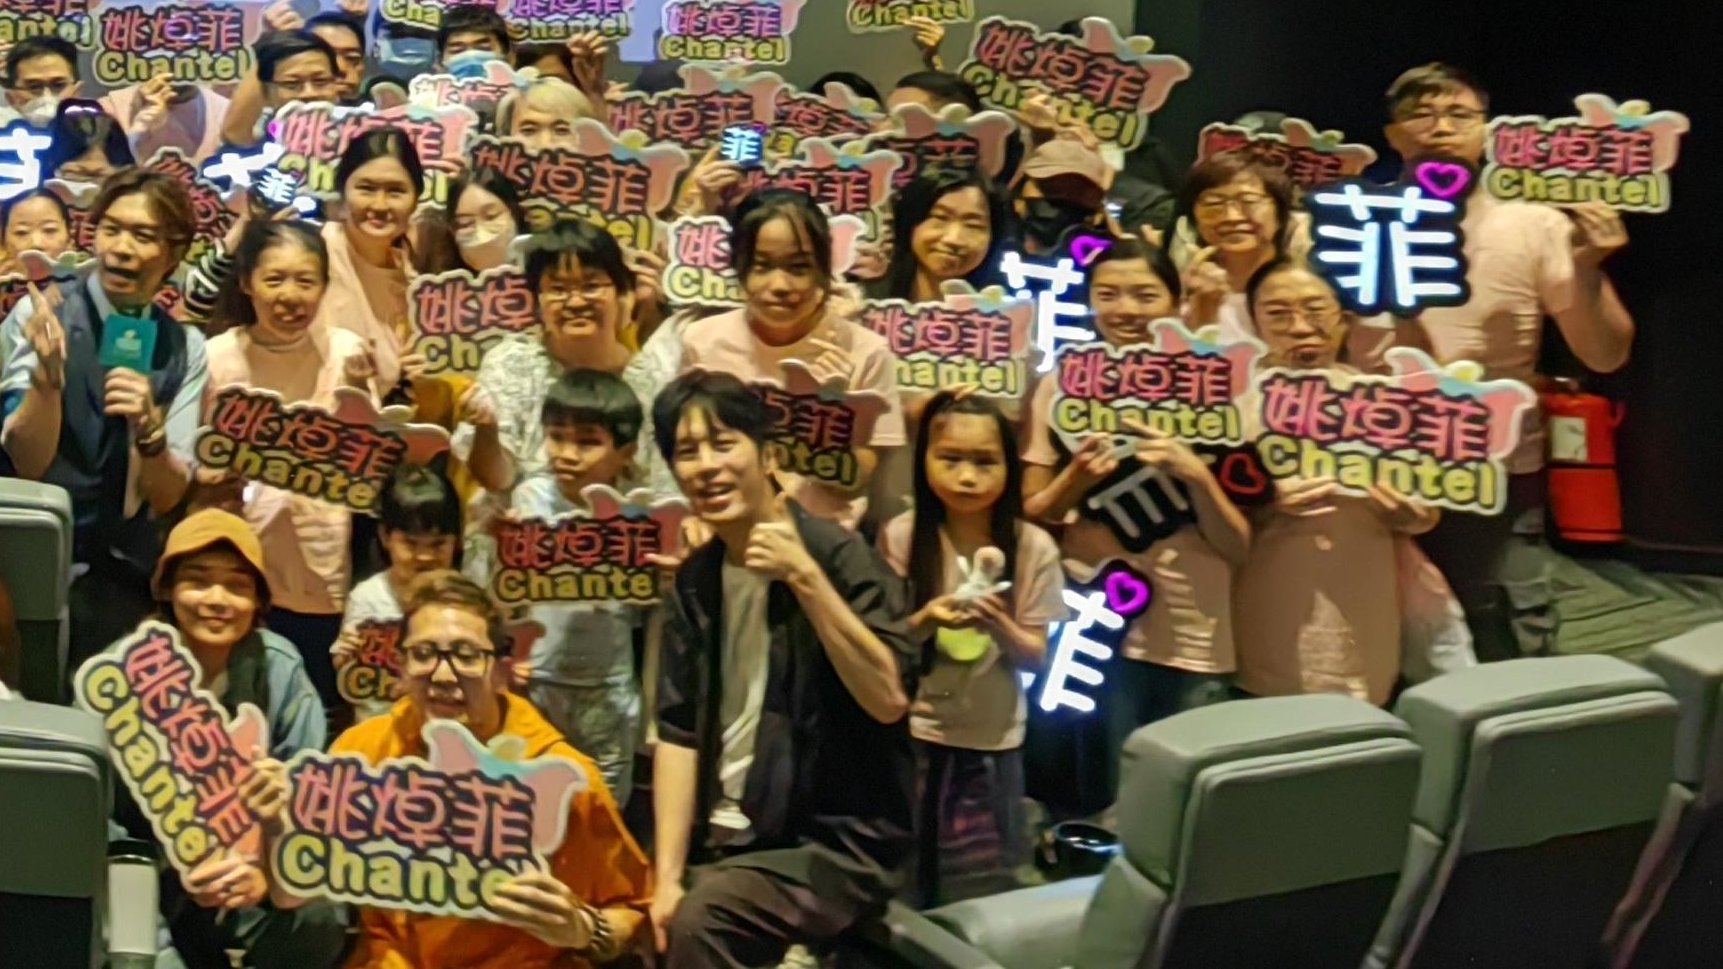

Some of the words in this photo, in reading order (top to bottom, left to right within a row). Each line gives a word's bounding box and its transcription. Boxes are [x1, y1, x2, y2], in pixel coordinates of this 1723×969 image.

[102, 6, 243, 52] 姚焯菲
[667, 2, 781, 37] 姚焯菲
[98, 49, 251, 80] Chantel
[663, 35, 787, 62] Chantel
[977, 23, 1149, 111] 姚焯菲
[1494, 124, 1655, 176] 姚焯菲
[1489, 166, 1663, 208] Chantel
[1314, 184, 1462, 306] 菲
[417, 279, 535, 331] 姚焯
[1059, 351, 1231, 405] 姚焯菲
[1262, 378, 1489, 461] 姚焯菲
[197, 433, 377, 509] Chante
[1257, 434, 1497, 508] Chantel
[500, 519, 661, 568] 姚焯菲
[498, 567, 654, 600] Chante
[86, 664, 209, 864] Chante
[125, 633, 252, 845] 姚焯菲
[294, 764, 535, 859] 姚焯菲
[282, 833, 515, 910] Chante
